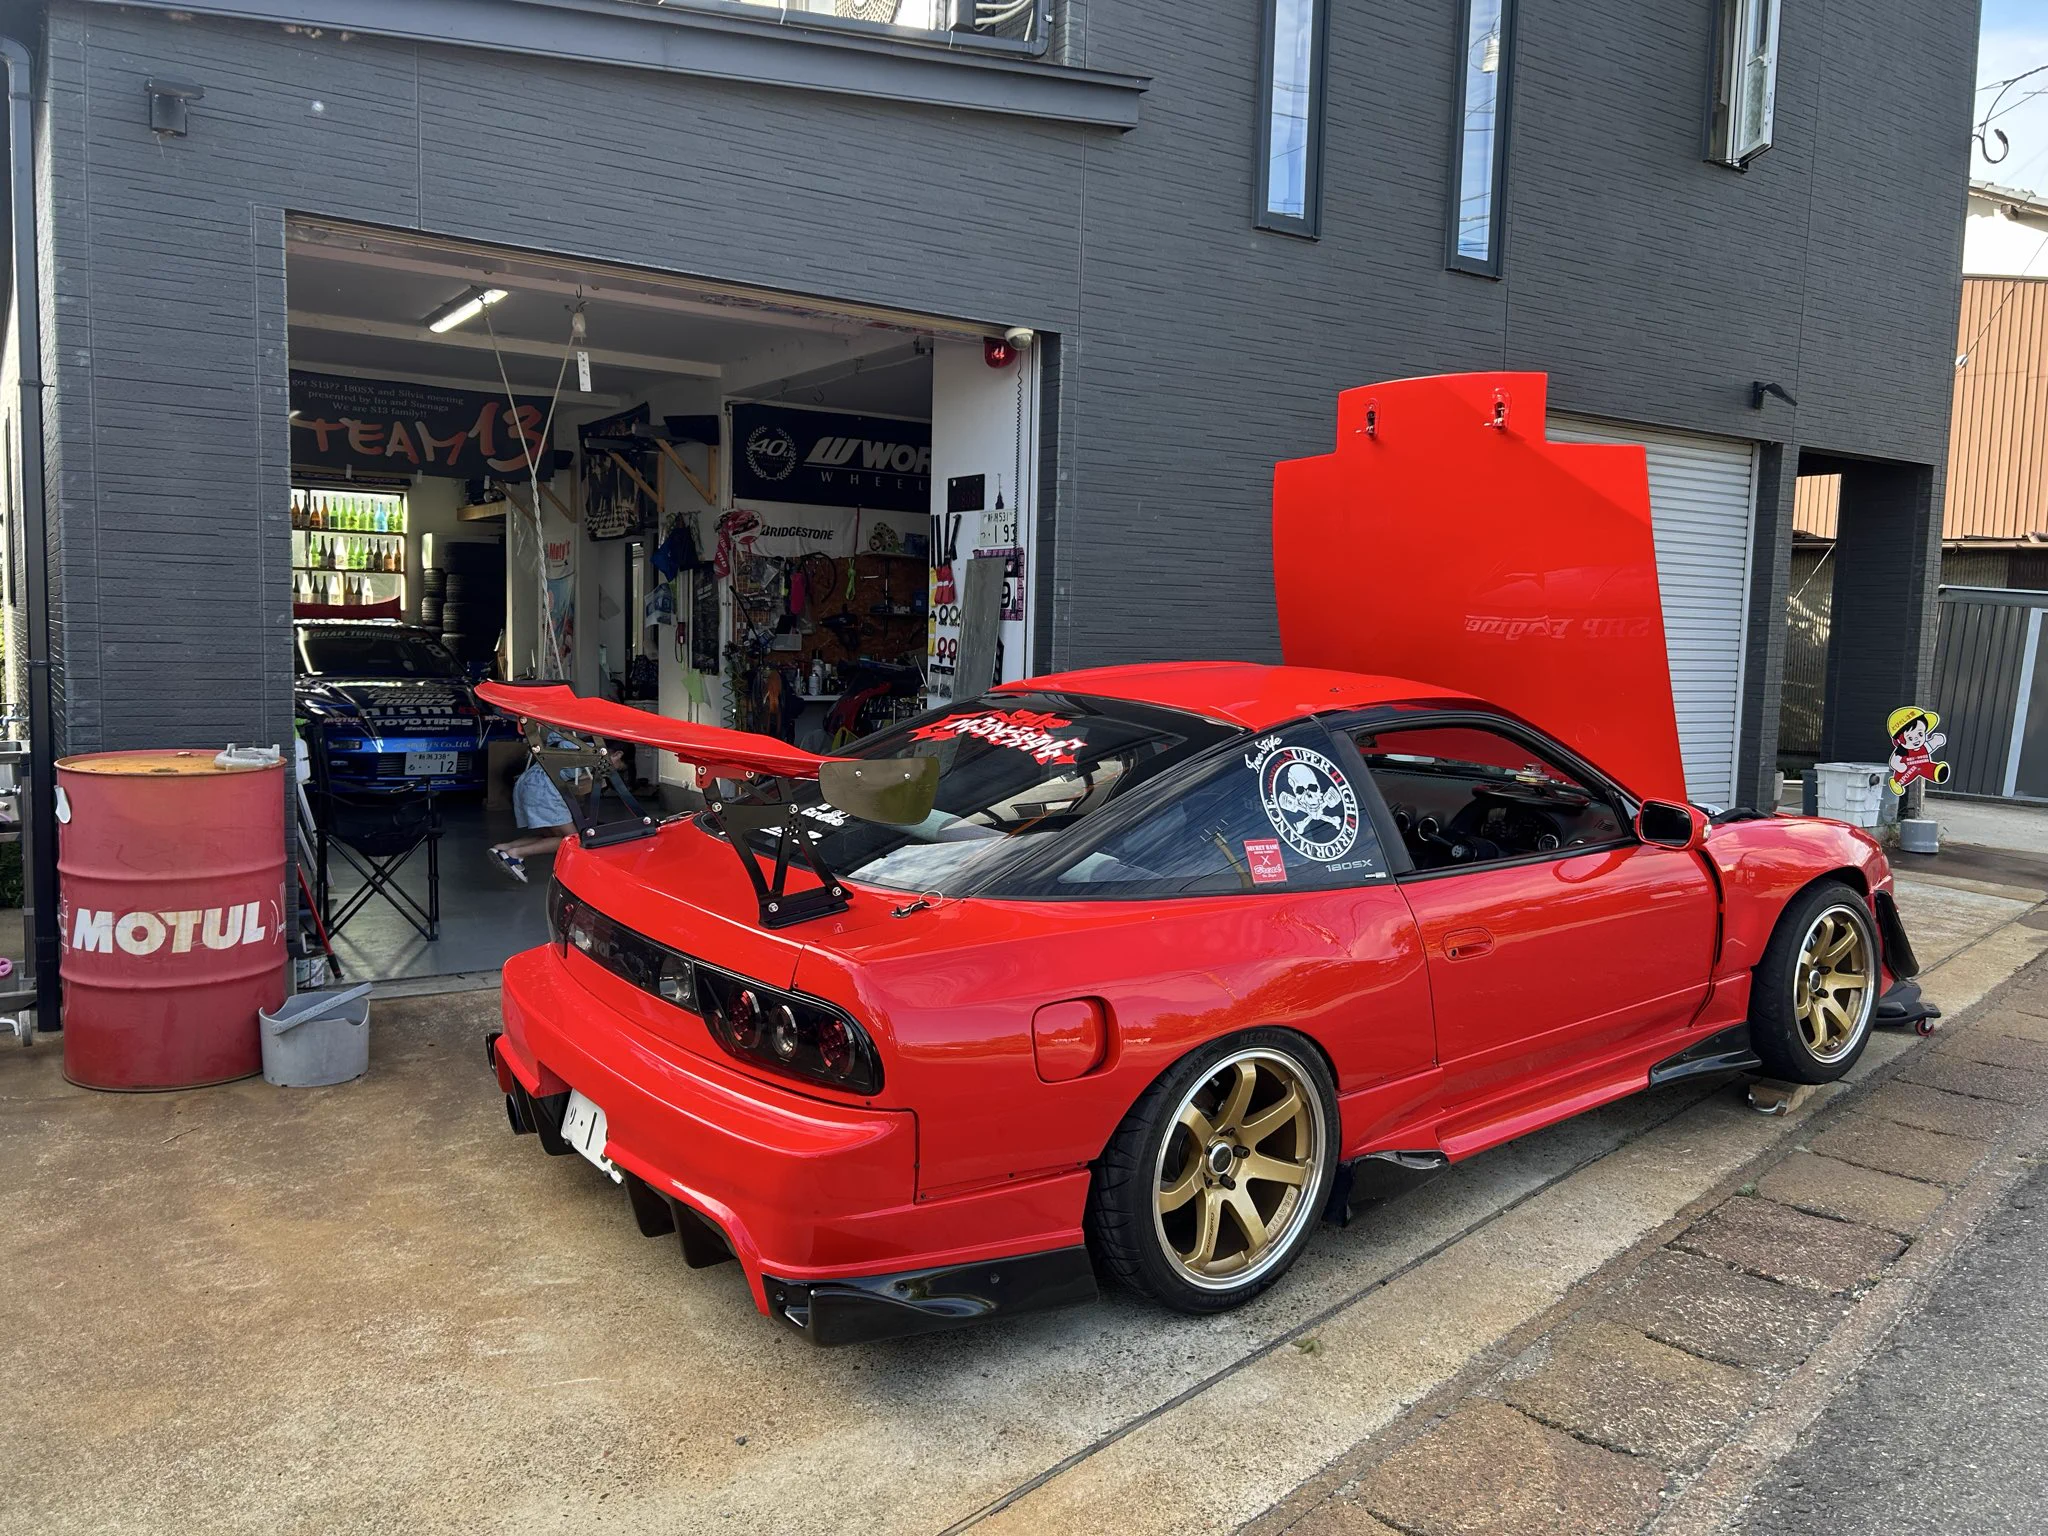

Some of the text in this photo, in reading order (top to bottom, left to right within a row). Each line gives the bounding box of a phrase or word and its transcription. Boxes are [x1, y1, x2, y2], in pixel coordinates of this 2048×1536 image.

[308, 390, 357, 402] presented
[358, 393, 371, 405] by
[389, 397, 408, 407] and
[410, 399, 449, 412] Suenaga
[343, 384, 375, 395] 180SX
[377, 388, 395, 397] and
[398, 390, 424, 400] Silvia
[427, 394, 464, 405] meeting
[332, 401, 349, 411] We
[352, 404, 368, 413] are
[370, 405, 389, 414] S13
[760, 524, 834, 541] BRIDGESTONE
[323, 716, 362, 724] MOTUL
[373, 718, 474, 727] TOYO TIRES
[1283, 748, 1330, 774] SUPER
[1325, 858, 1373, 873] 180SX
[71, 900, 266, 957] MOTUL
